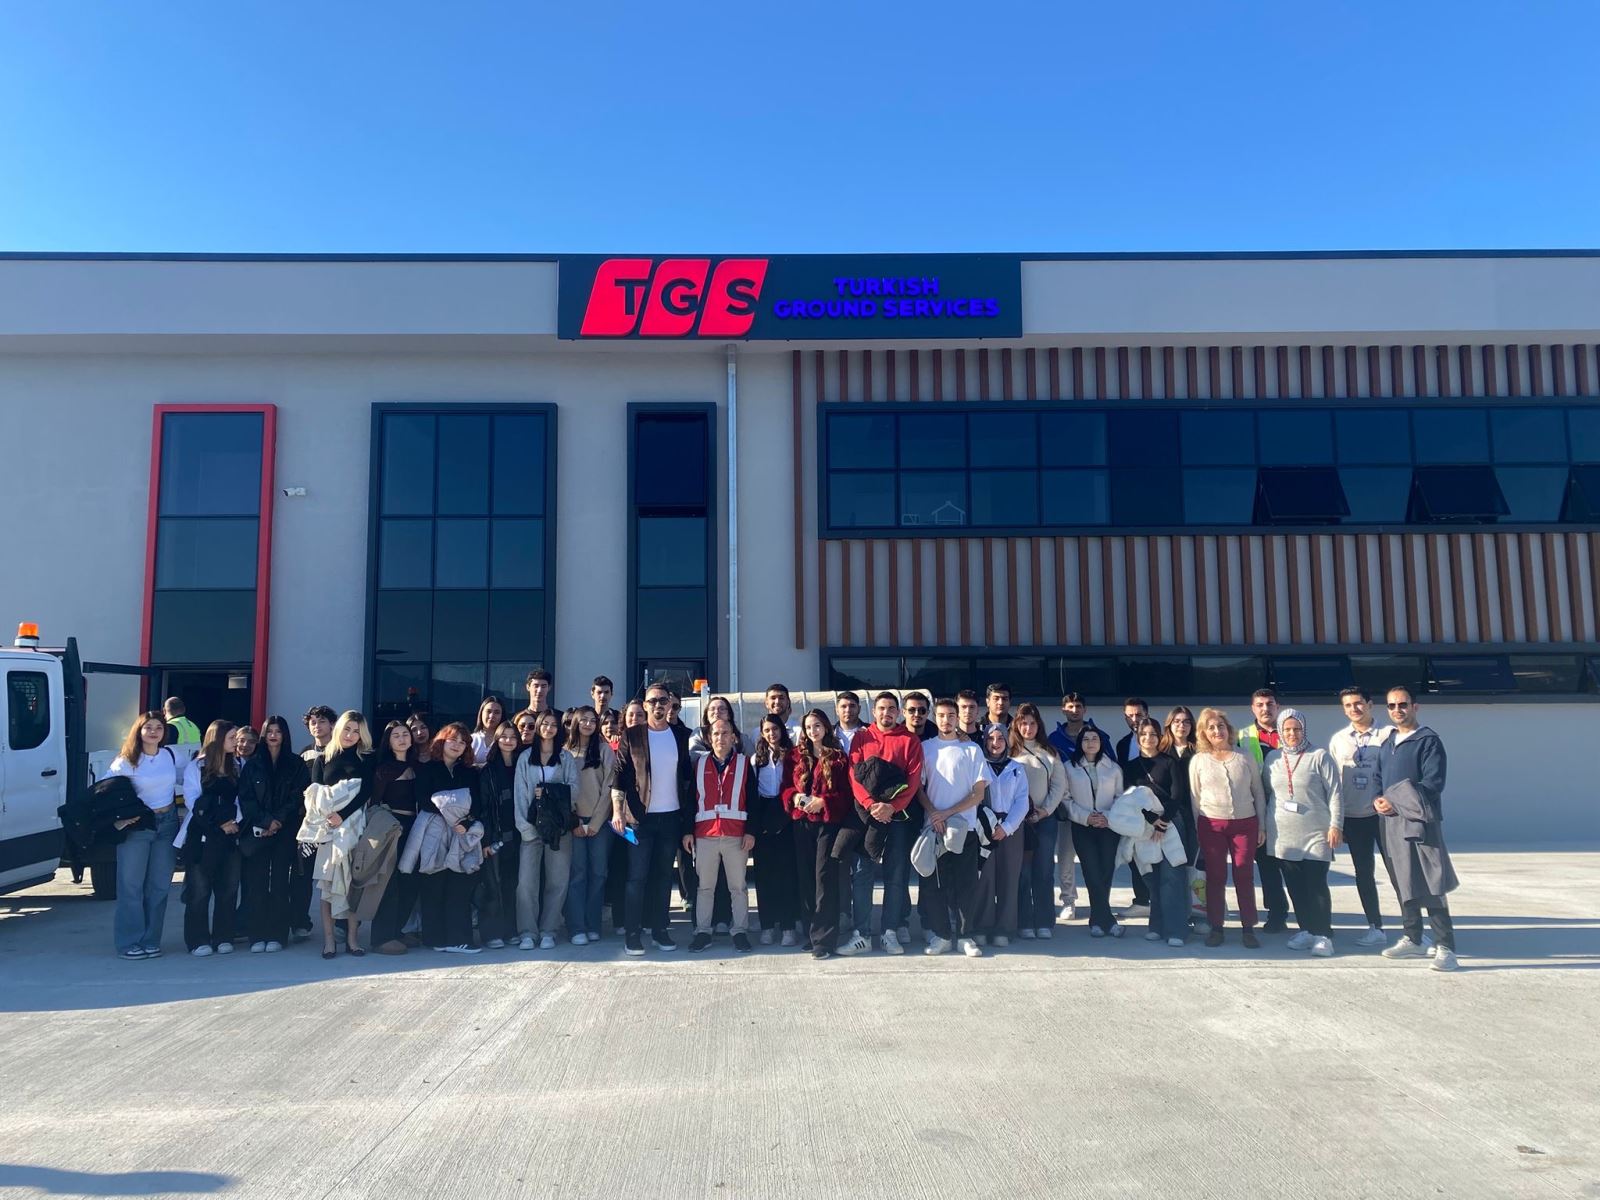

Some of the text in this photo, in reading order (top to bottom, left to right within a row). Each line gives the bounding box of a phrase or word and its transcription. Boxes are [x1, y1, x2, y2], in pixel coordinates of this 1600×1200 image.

[833, 276, 939, 296] TURKISH
[614, 278, 758, 316] TGS
[774, 298, 999, 318] GROUND SERVICES
